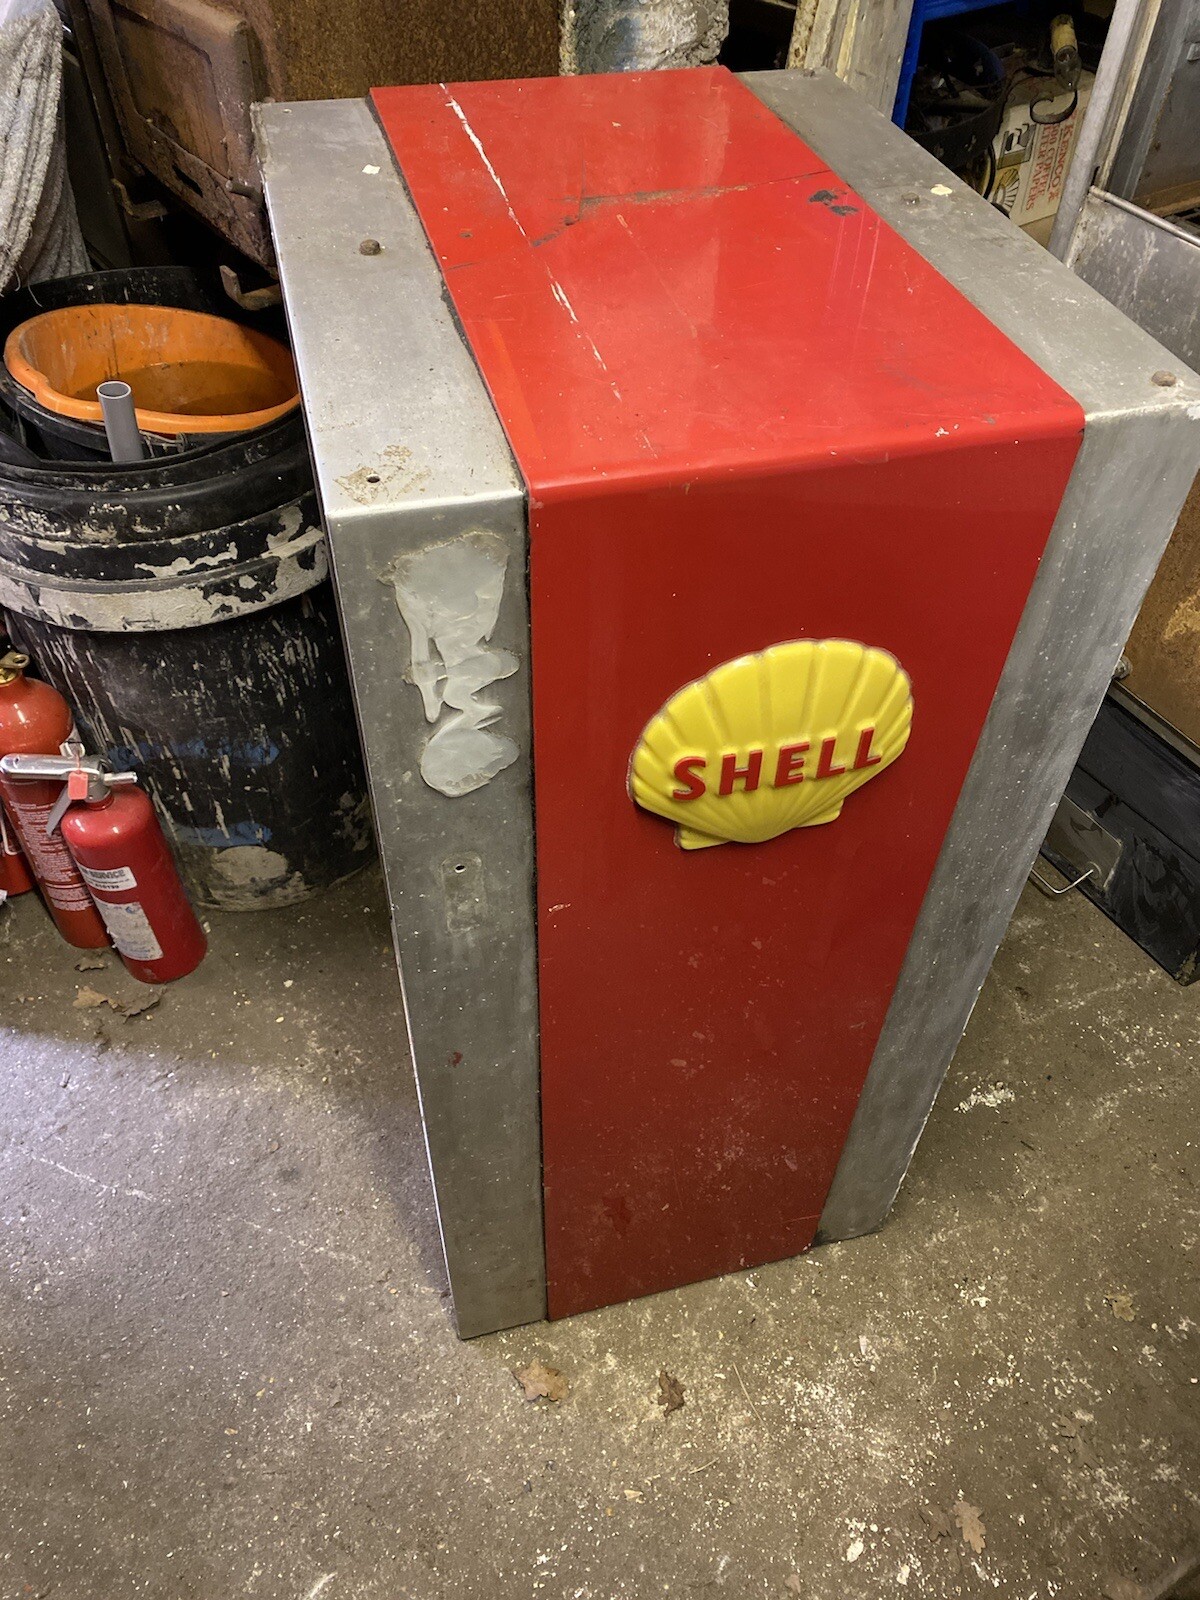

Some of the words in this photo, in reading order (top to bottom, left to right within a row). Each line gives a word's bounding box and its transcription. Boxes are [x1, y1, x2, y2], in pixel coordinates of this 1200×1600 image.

[1037, 124, 1051, 159] LTER
[1052, 125, 1074, 187] KENCO
[1026, 162, 1044, 211] PAPERS
[1037, 147, 1055, 197] COFFEE
[672, 726, 882, 801] SHELL
